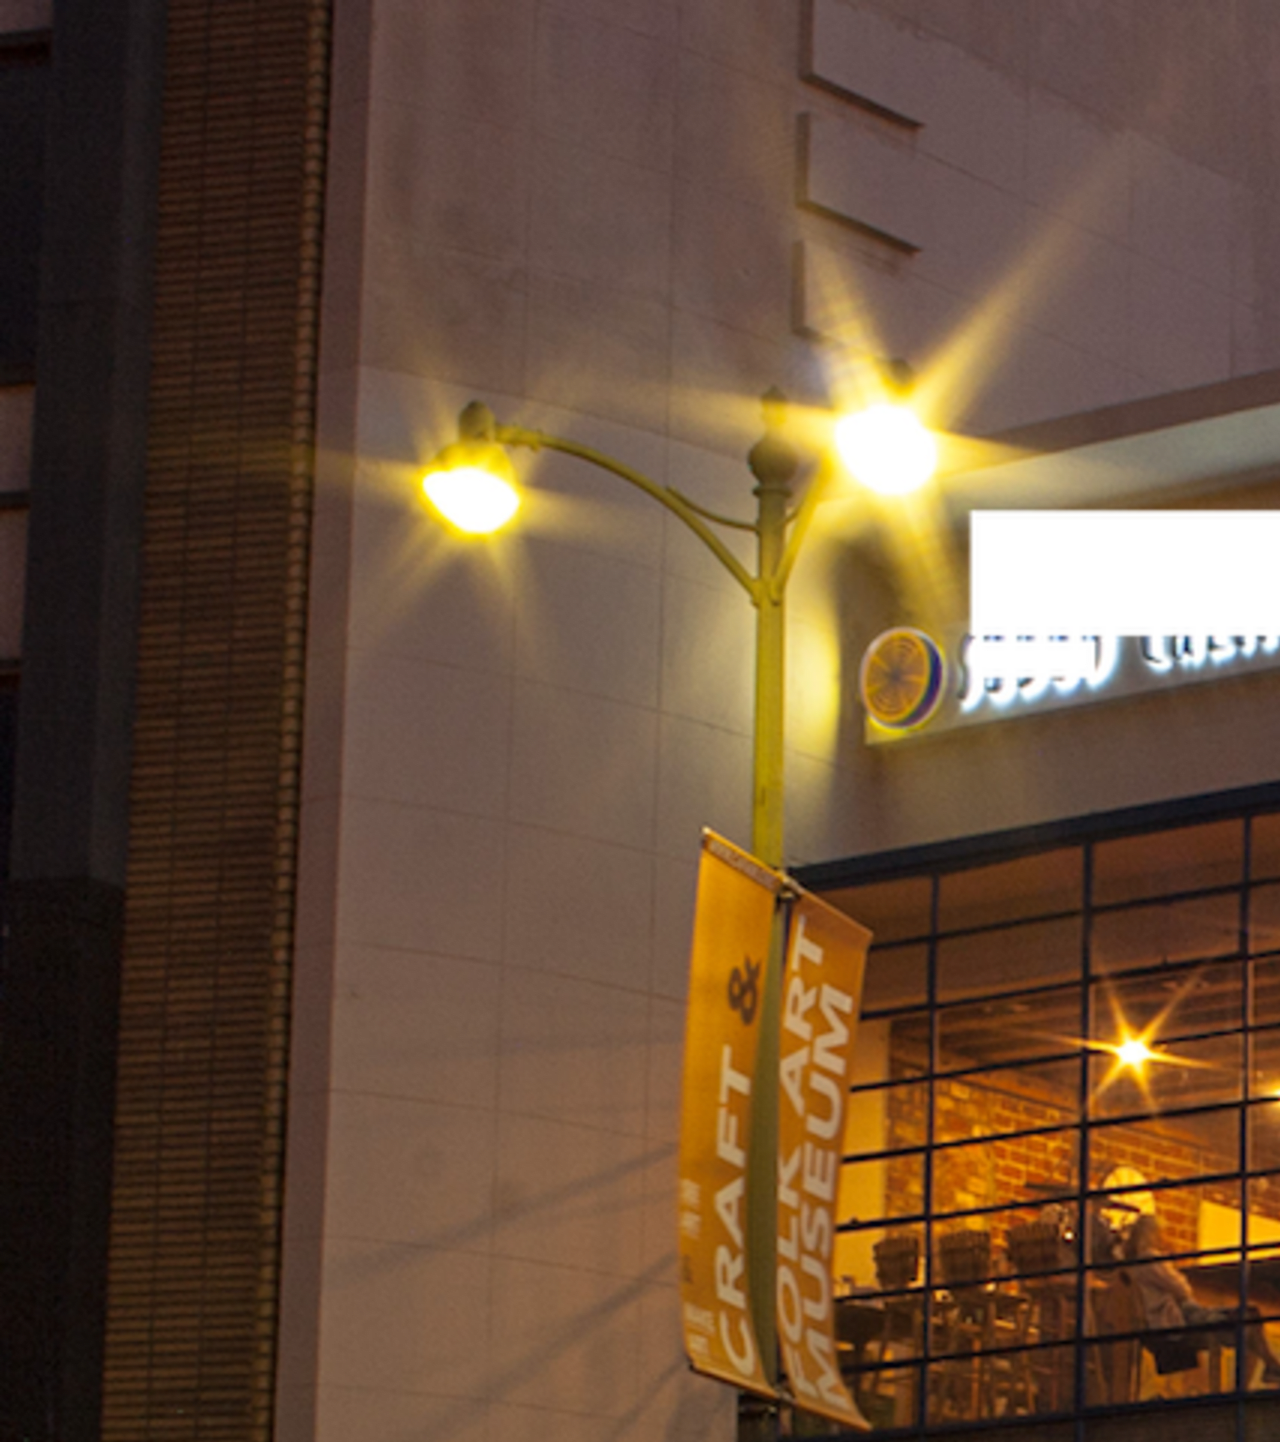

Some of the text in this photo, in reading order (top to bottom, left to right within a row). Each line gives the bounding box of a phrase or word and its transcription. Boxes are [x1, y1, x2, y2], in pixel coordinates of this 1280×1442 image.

[714, 955, 761, 1377] CRAFT &
[777, 913, 824, 1399] FOLK ART
[800, 982, 854, 1411] MUSEUM
